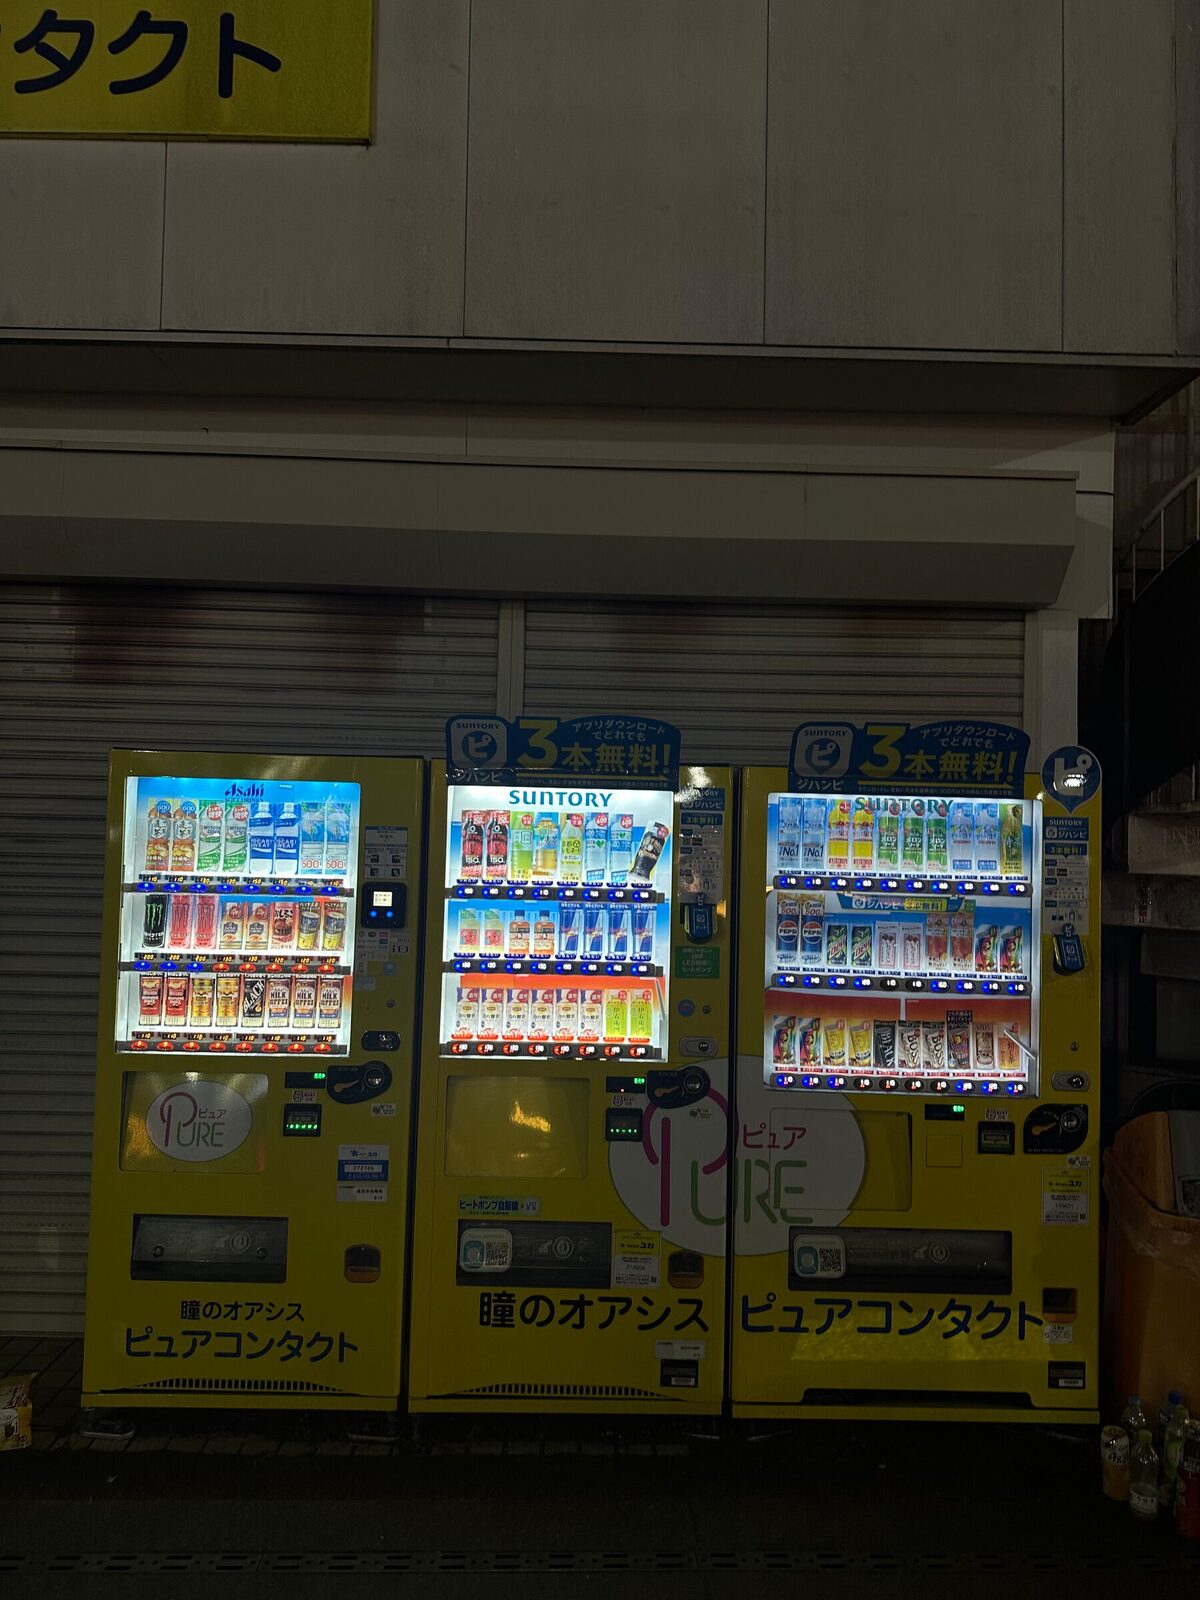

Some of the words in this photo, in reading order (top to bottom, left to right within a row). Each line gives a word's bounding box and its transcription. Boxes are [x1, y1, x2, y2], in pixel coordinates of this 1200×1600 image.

[456, 722, 499, 730] SUNTORY
[572, 719, 665, 736] アプリダウンロード
[920, 724, 1017, 741] アプリダウンロード
[592, 731, 646, 742] でどれでも
[939, 737, 994, 749] でどれでも
[225, 782, 265, 798] Asahi
[797, 779, 845, 790] ジハンピ
[509, 790, 613, 808] SUNTORY
[855, 797, 954, 812] SUNTORY
[160, 1092, 225, 1147] PURE
[198, 1108, 227, 1120] ピュア
[743, 1123, 806, 1150] ピュア
[181, 1300, 305, 1321] 瞳のオアシス
[479, 1291, 709, 1332] 瞳のオアシス
[741, 1292, 1044, 1340] ピュアコンタクト
[125, 1326, 358, 1362] ピュアコンタクト
